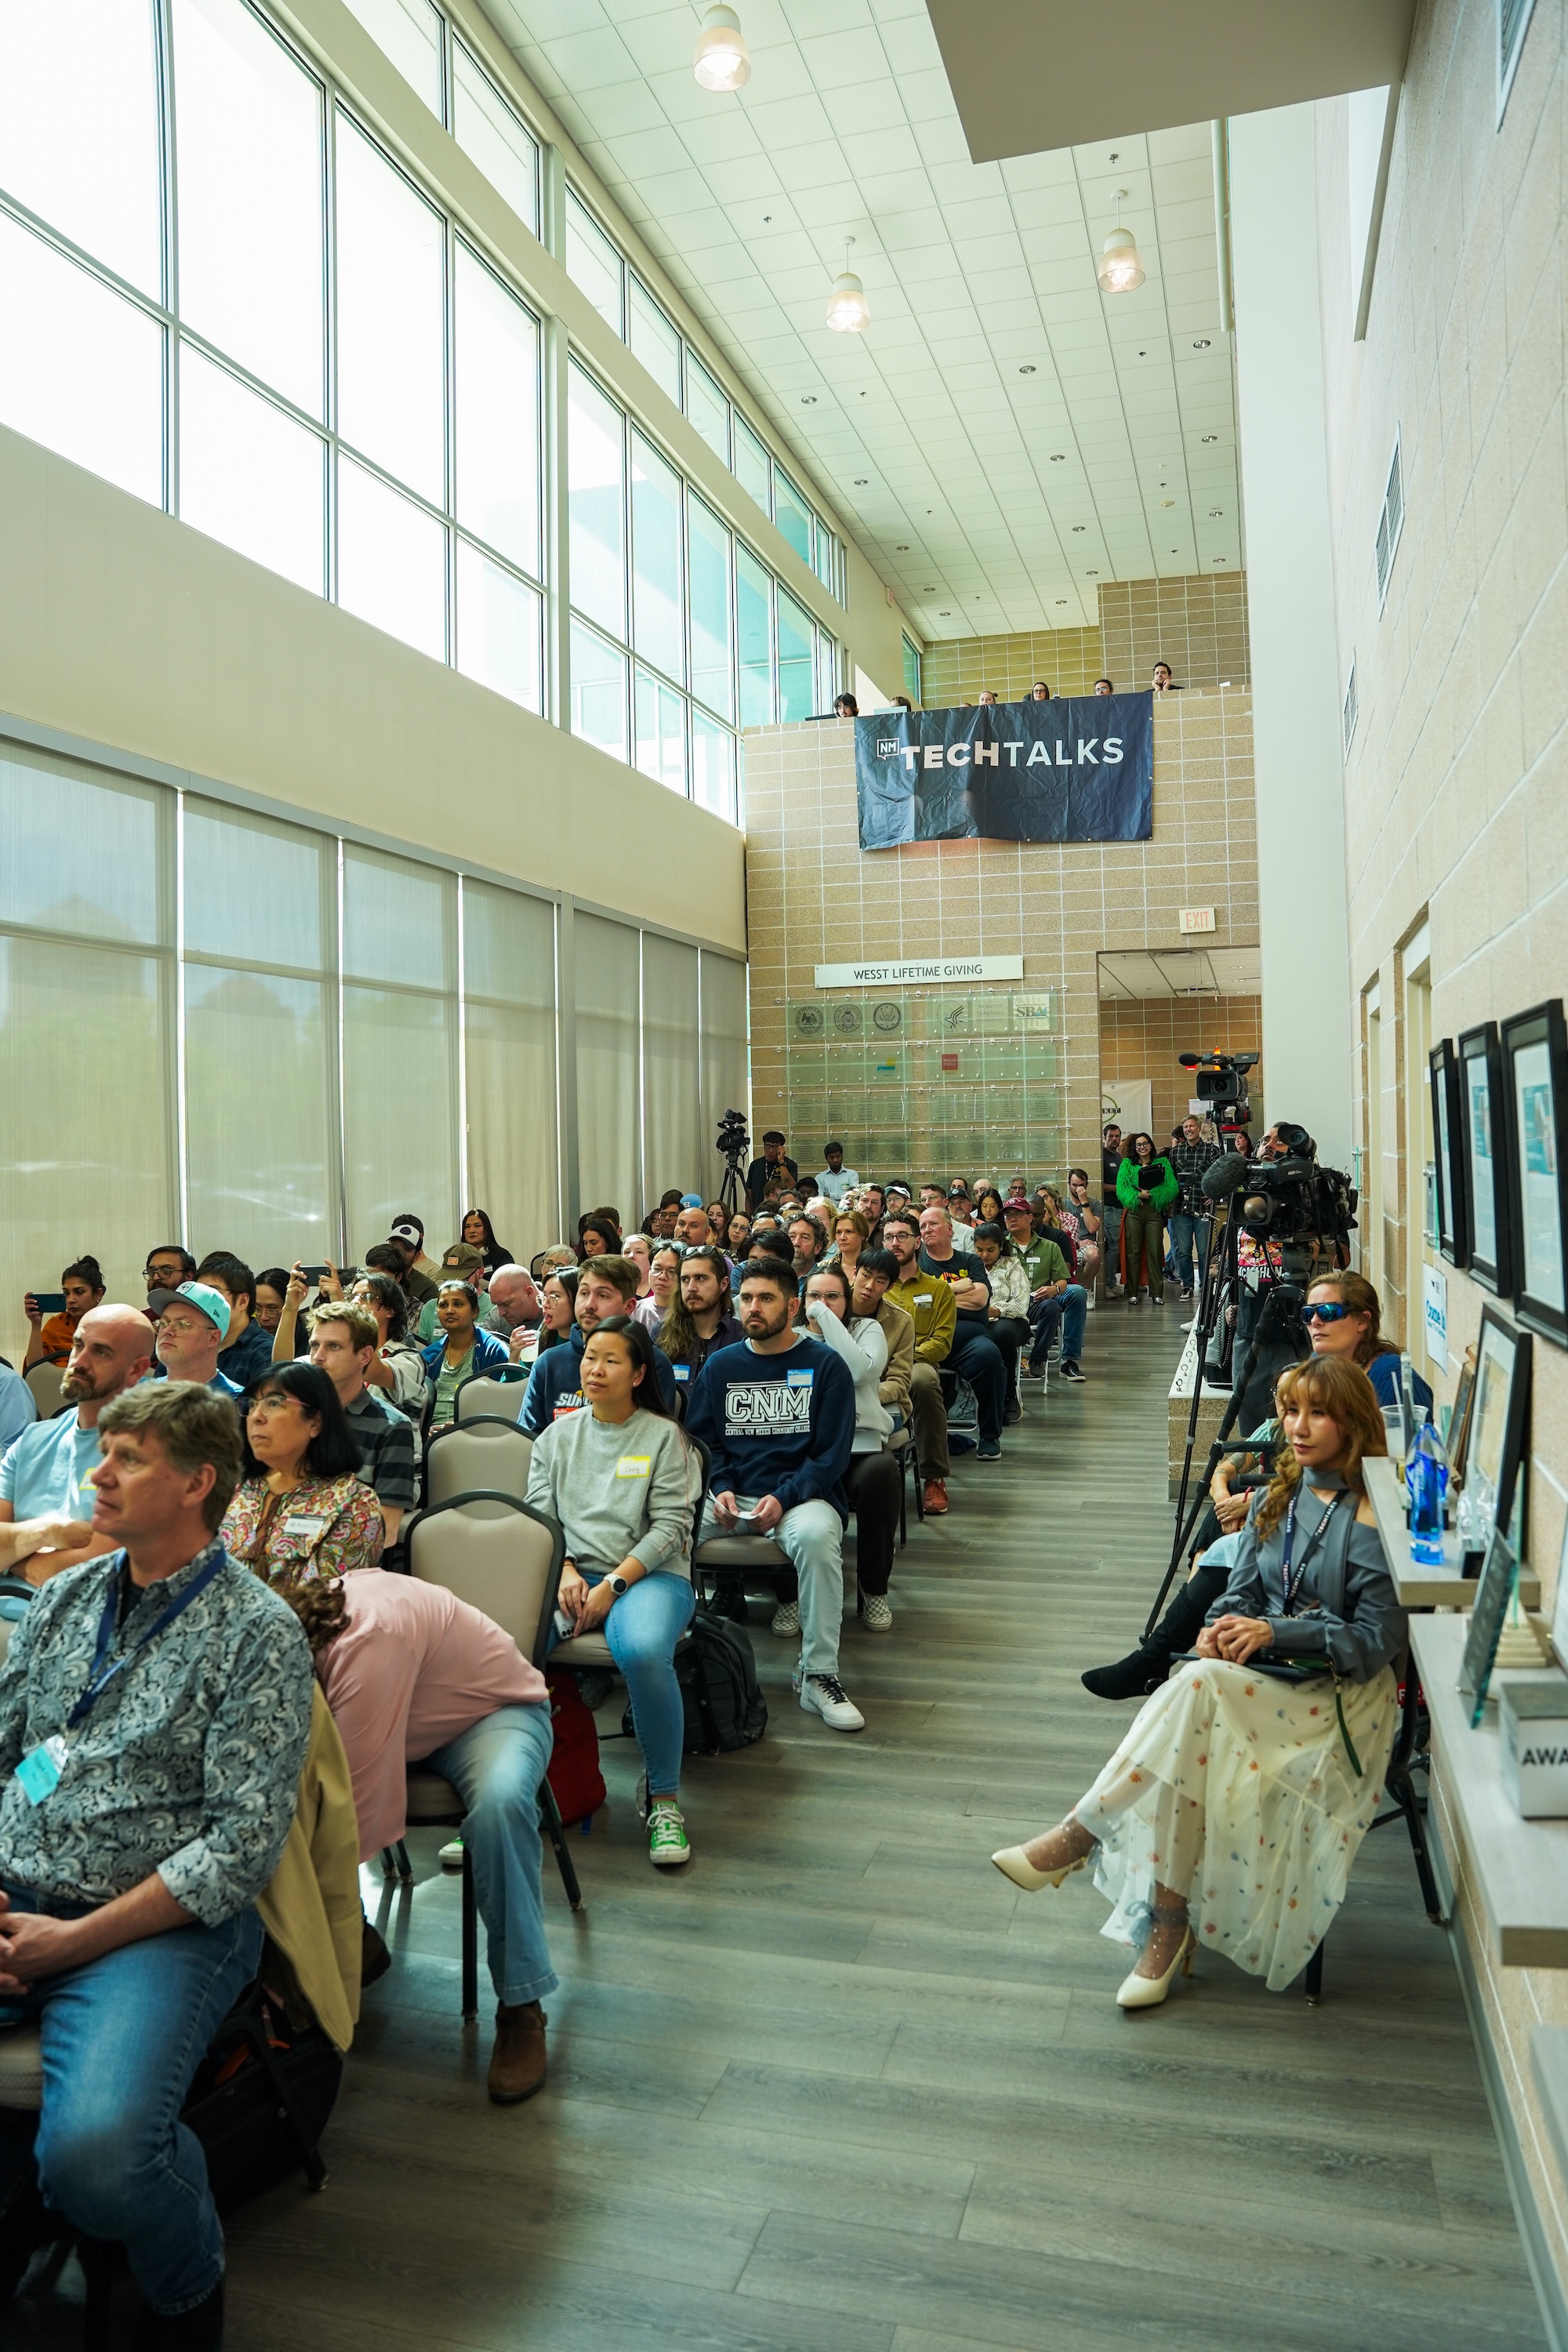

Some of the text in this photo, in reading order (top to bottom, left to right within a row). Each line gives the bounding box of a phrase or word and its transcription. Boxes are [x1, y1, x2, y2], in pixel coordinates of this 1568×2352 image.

[880, 738, 1124, 770] NM TECHTALKS
[1185, 911, 1210, 929] EXIT
[854, 964, 983, 980] WESST LIFETIME GIVING
[1016, 1006, 1047, 1017] SBA
[725, 1386, 813, 1422] CNM
[1287, 1499, 1295, 1533] TECHTALKS
[1317, 1501, 1338, 1534] TECHTALKS
[1290, 1563, 1306, 1597] TECHTALKS
[1522, 1747, 1568, 1766] AWA
